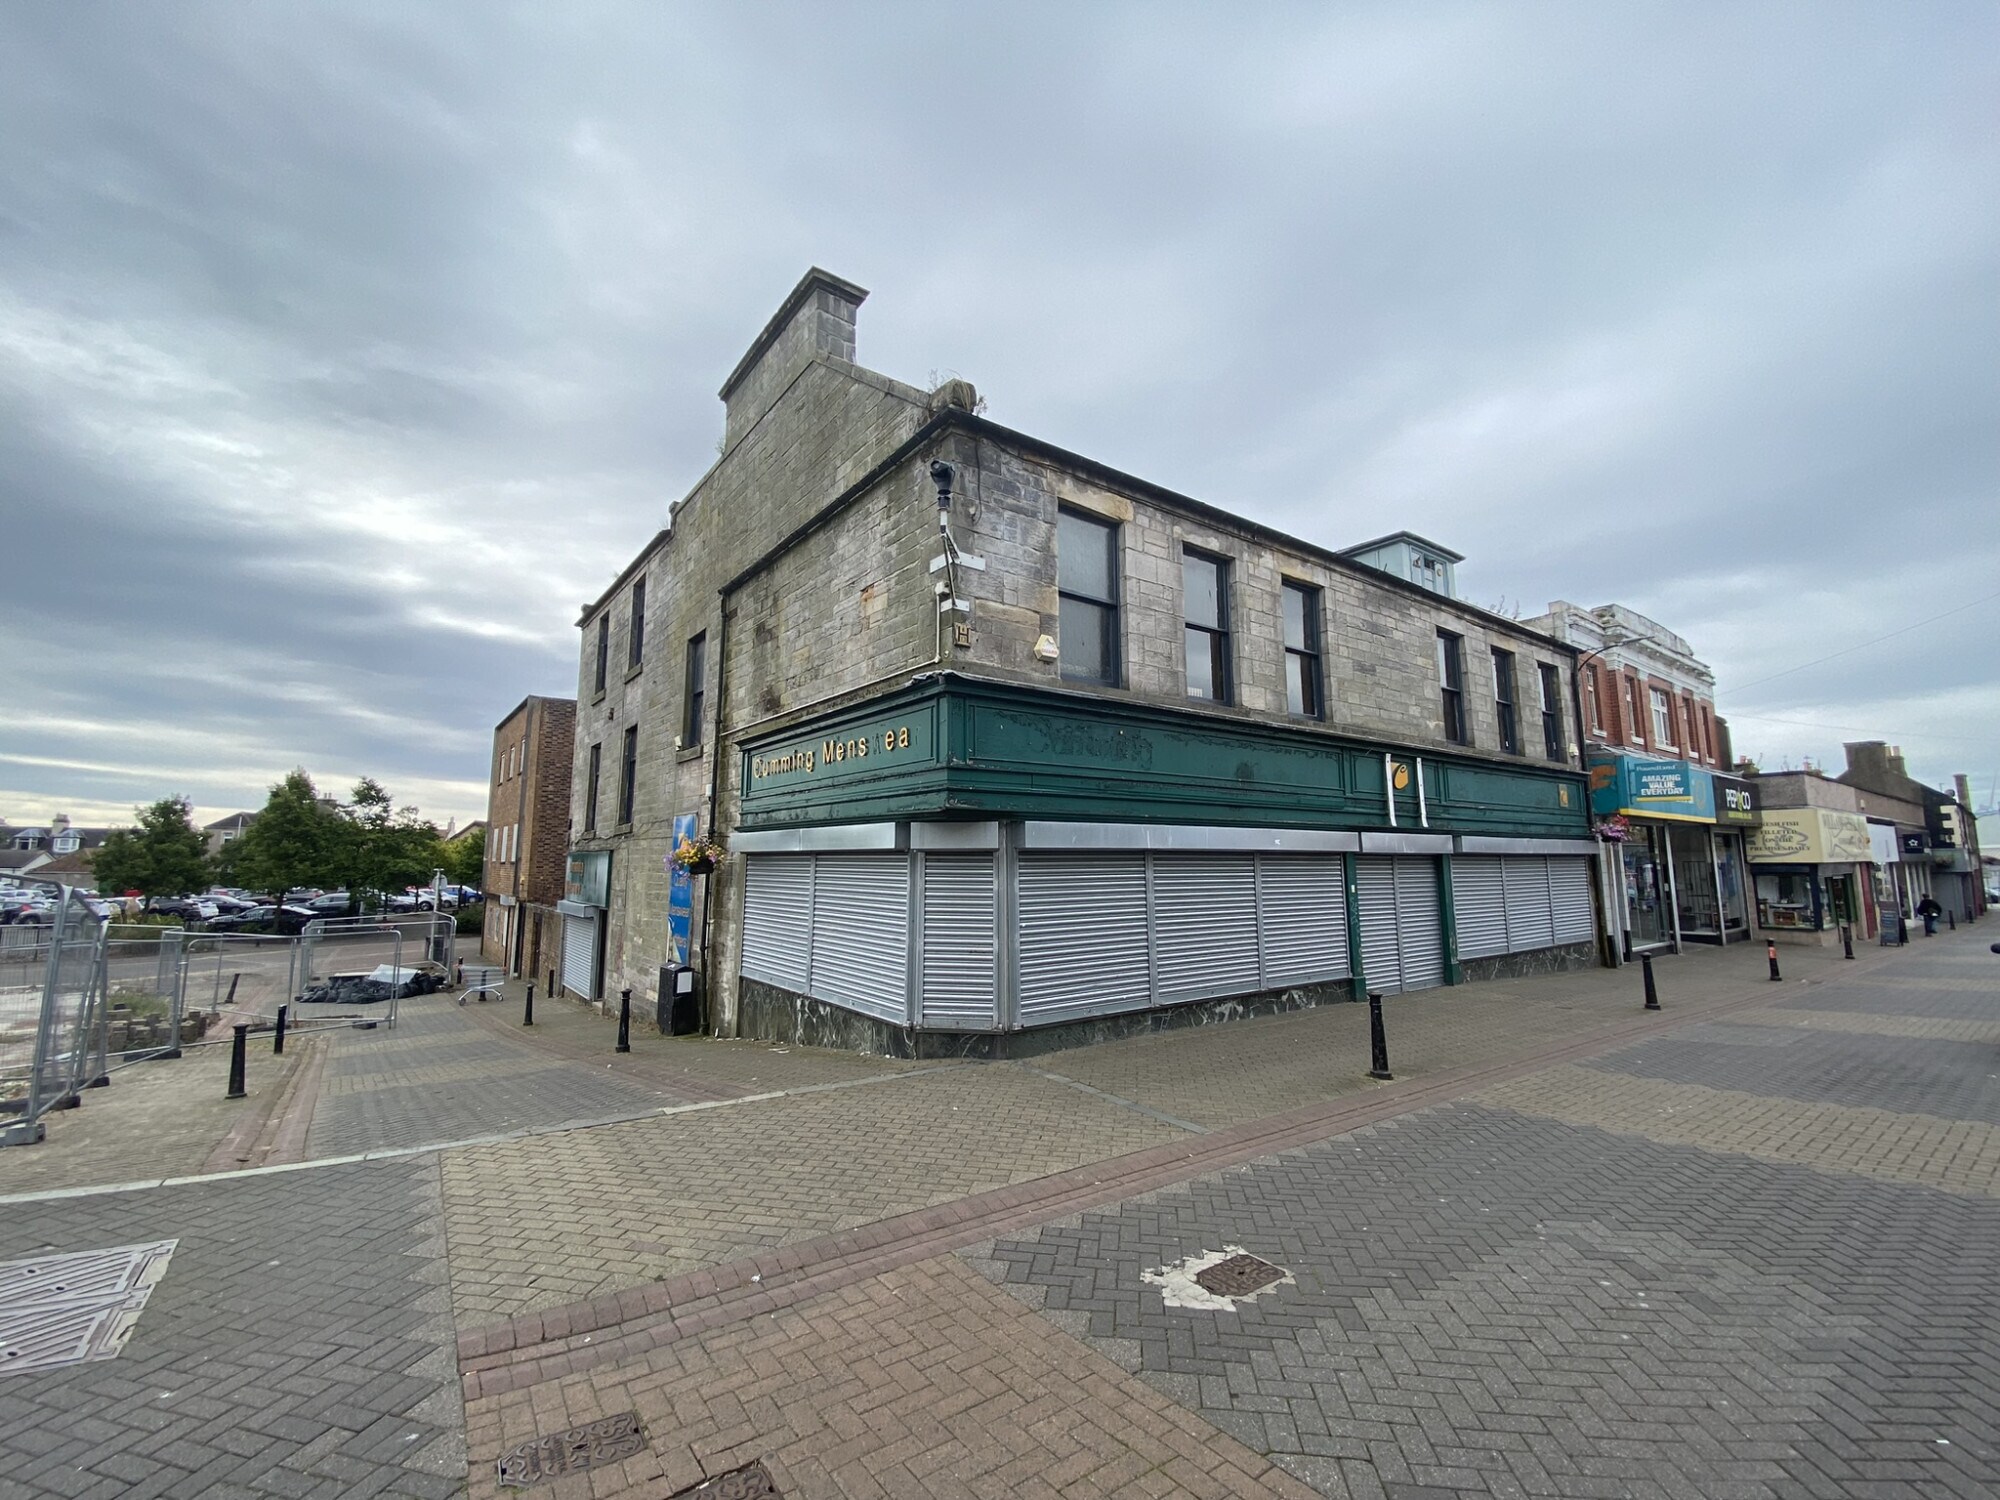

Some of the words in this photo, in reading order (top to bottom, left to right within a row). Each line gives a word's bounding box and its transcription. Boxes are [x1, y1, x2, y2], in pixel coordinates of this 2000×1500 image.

[754, 749, 814, 779] Cumming
[822, 736, 867, 764] Mens
[1641, 773, 1681, 783] AMAZING
[1648, 780, 1676, 789] VALUE
[1640, 787, 1685, 796] EVERYDAY
